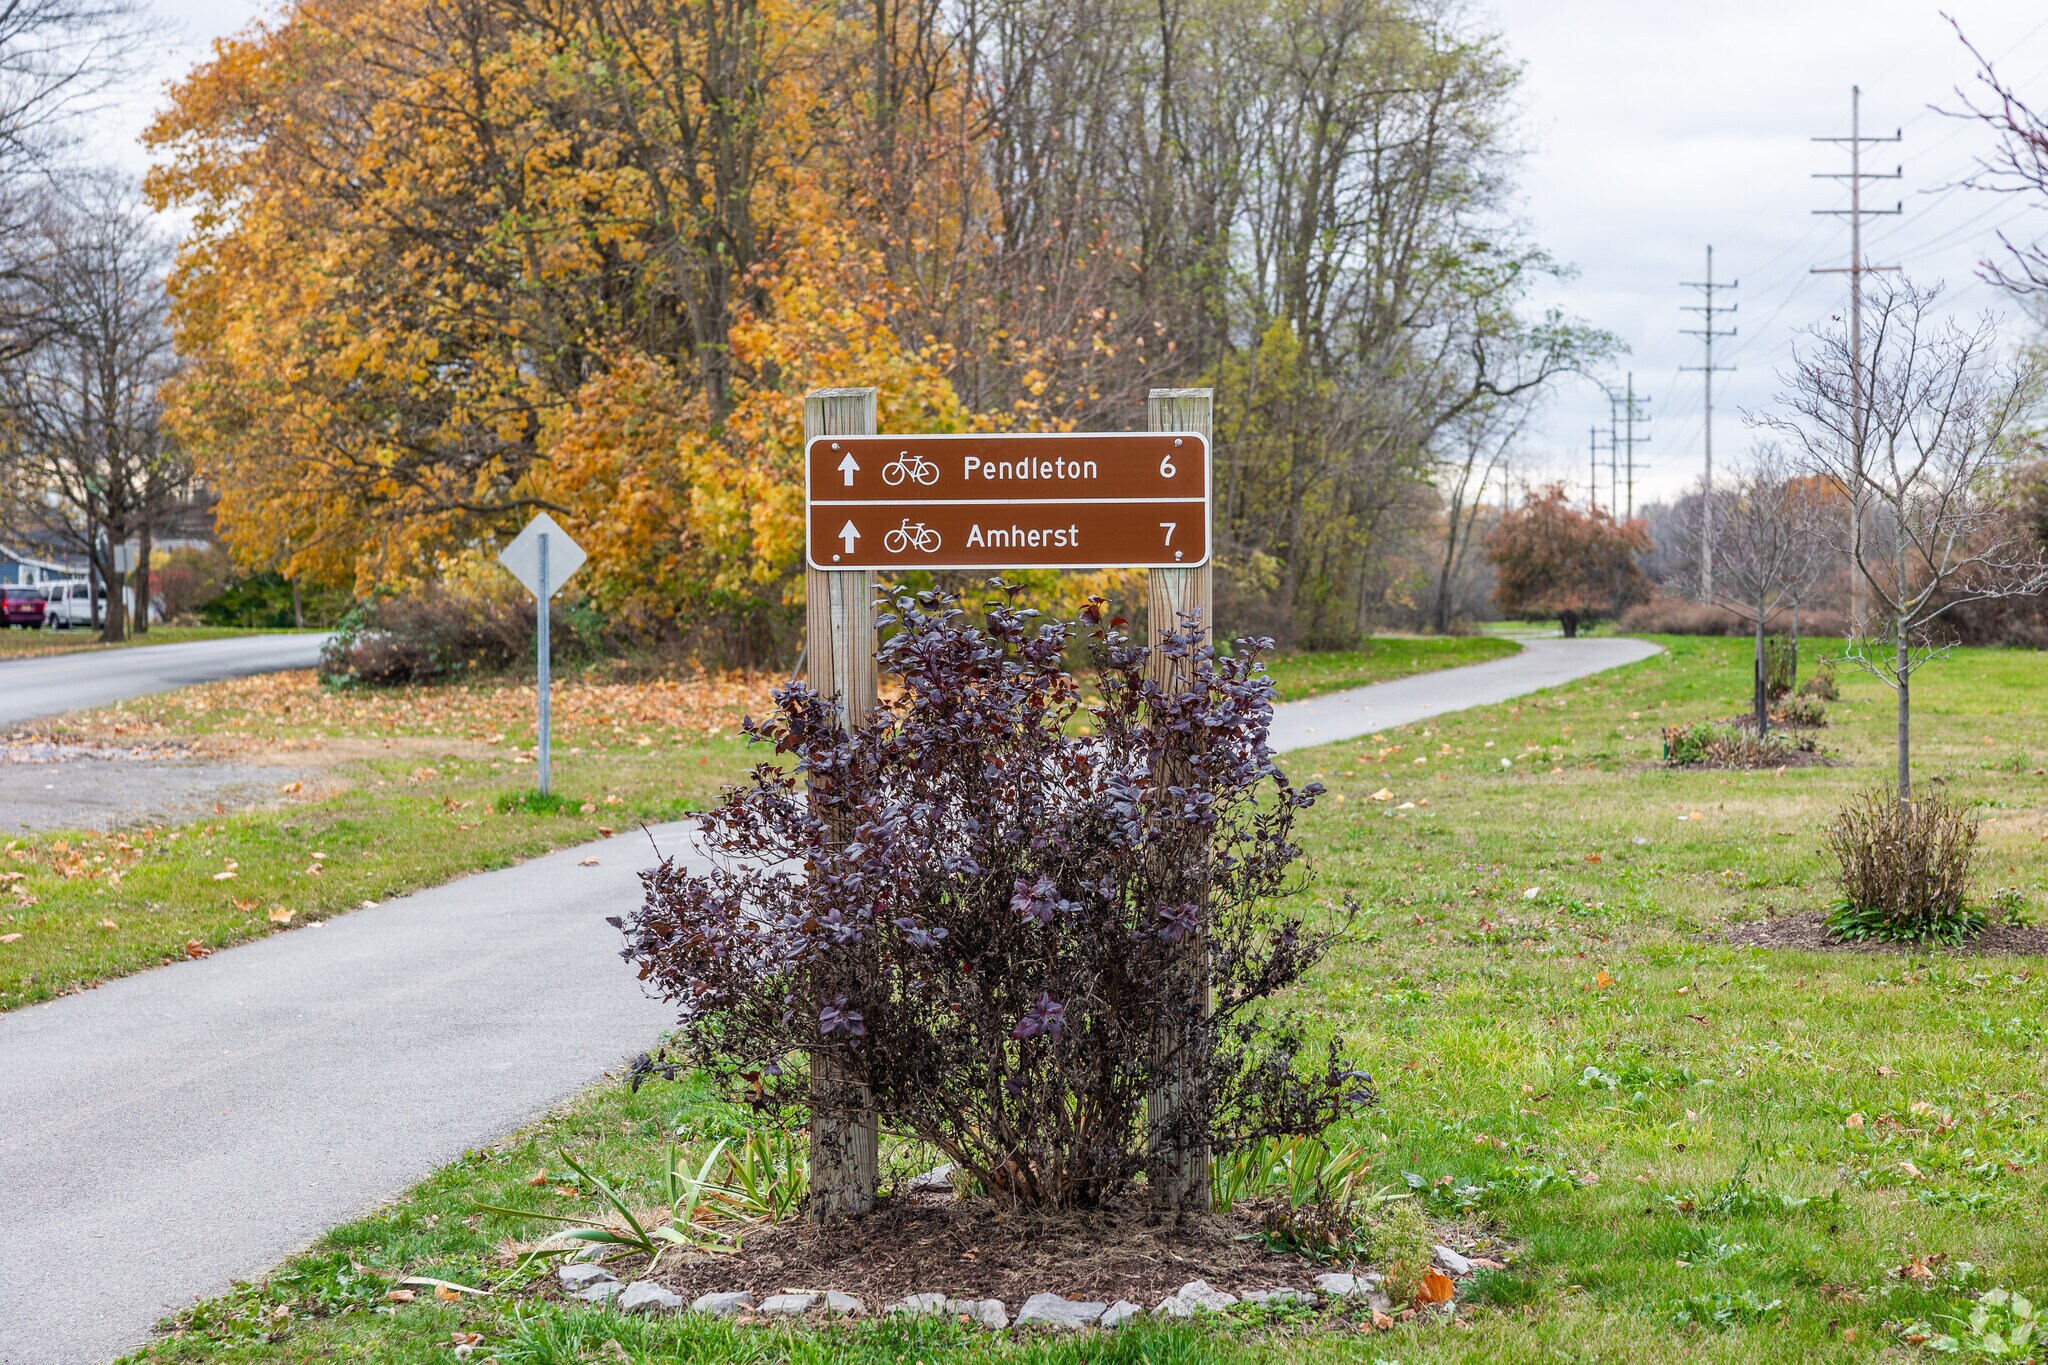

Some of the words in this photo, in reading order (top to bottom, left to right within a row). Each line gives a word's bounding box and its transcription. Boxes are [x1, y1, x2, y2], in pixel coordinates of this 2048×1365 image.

[964, 456, 1098, 480] Pendleton
[1159, 454, 1177, 479] 6
[965, 523, 1079, 548] Amherst
[1159, 522, 1177, 546] 7
